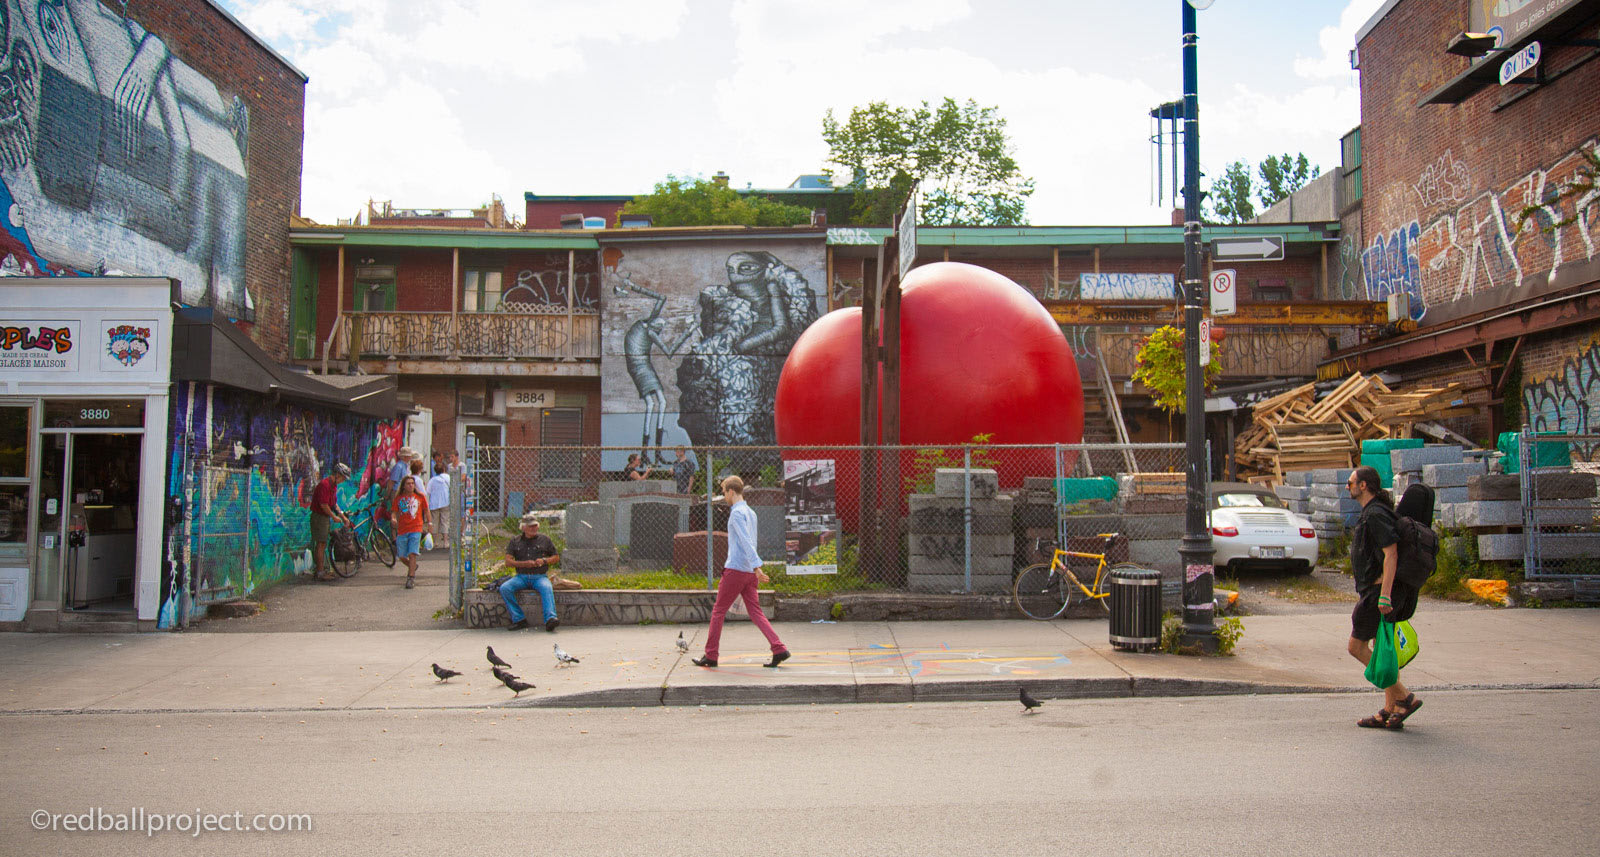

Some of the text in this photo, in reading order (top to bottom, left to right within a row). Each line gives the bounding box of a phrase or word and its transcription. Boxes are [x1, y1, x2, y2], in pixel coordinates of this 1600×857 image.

[1515, 19, 1528, 32] Les
[1528, 7, 1545, 28] joies
[1546, 1, 1556, 12] de
[1513, 44, 1536, 74] CBS
[1105, 311, 1152, 321] TONNES
[33, 359, 66, 368] MAISON
[515, 392, 545, 404] 3884
[80, 408, 110, 420] 3880
